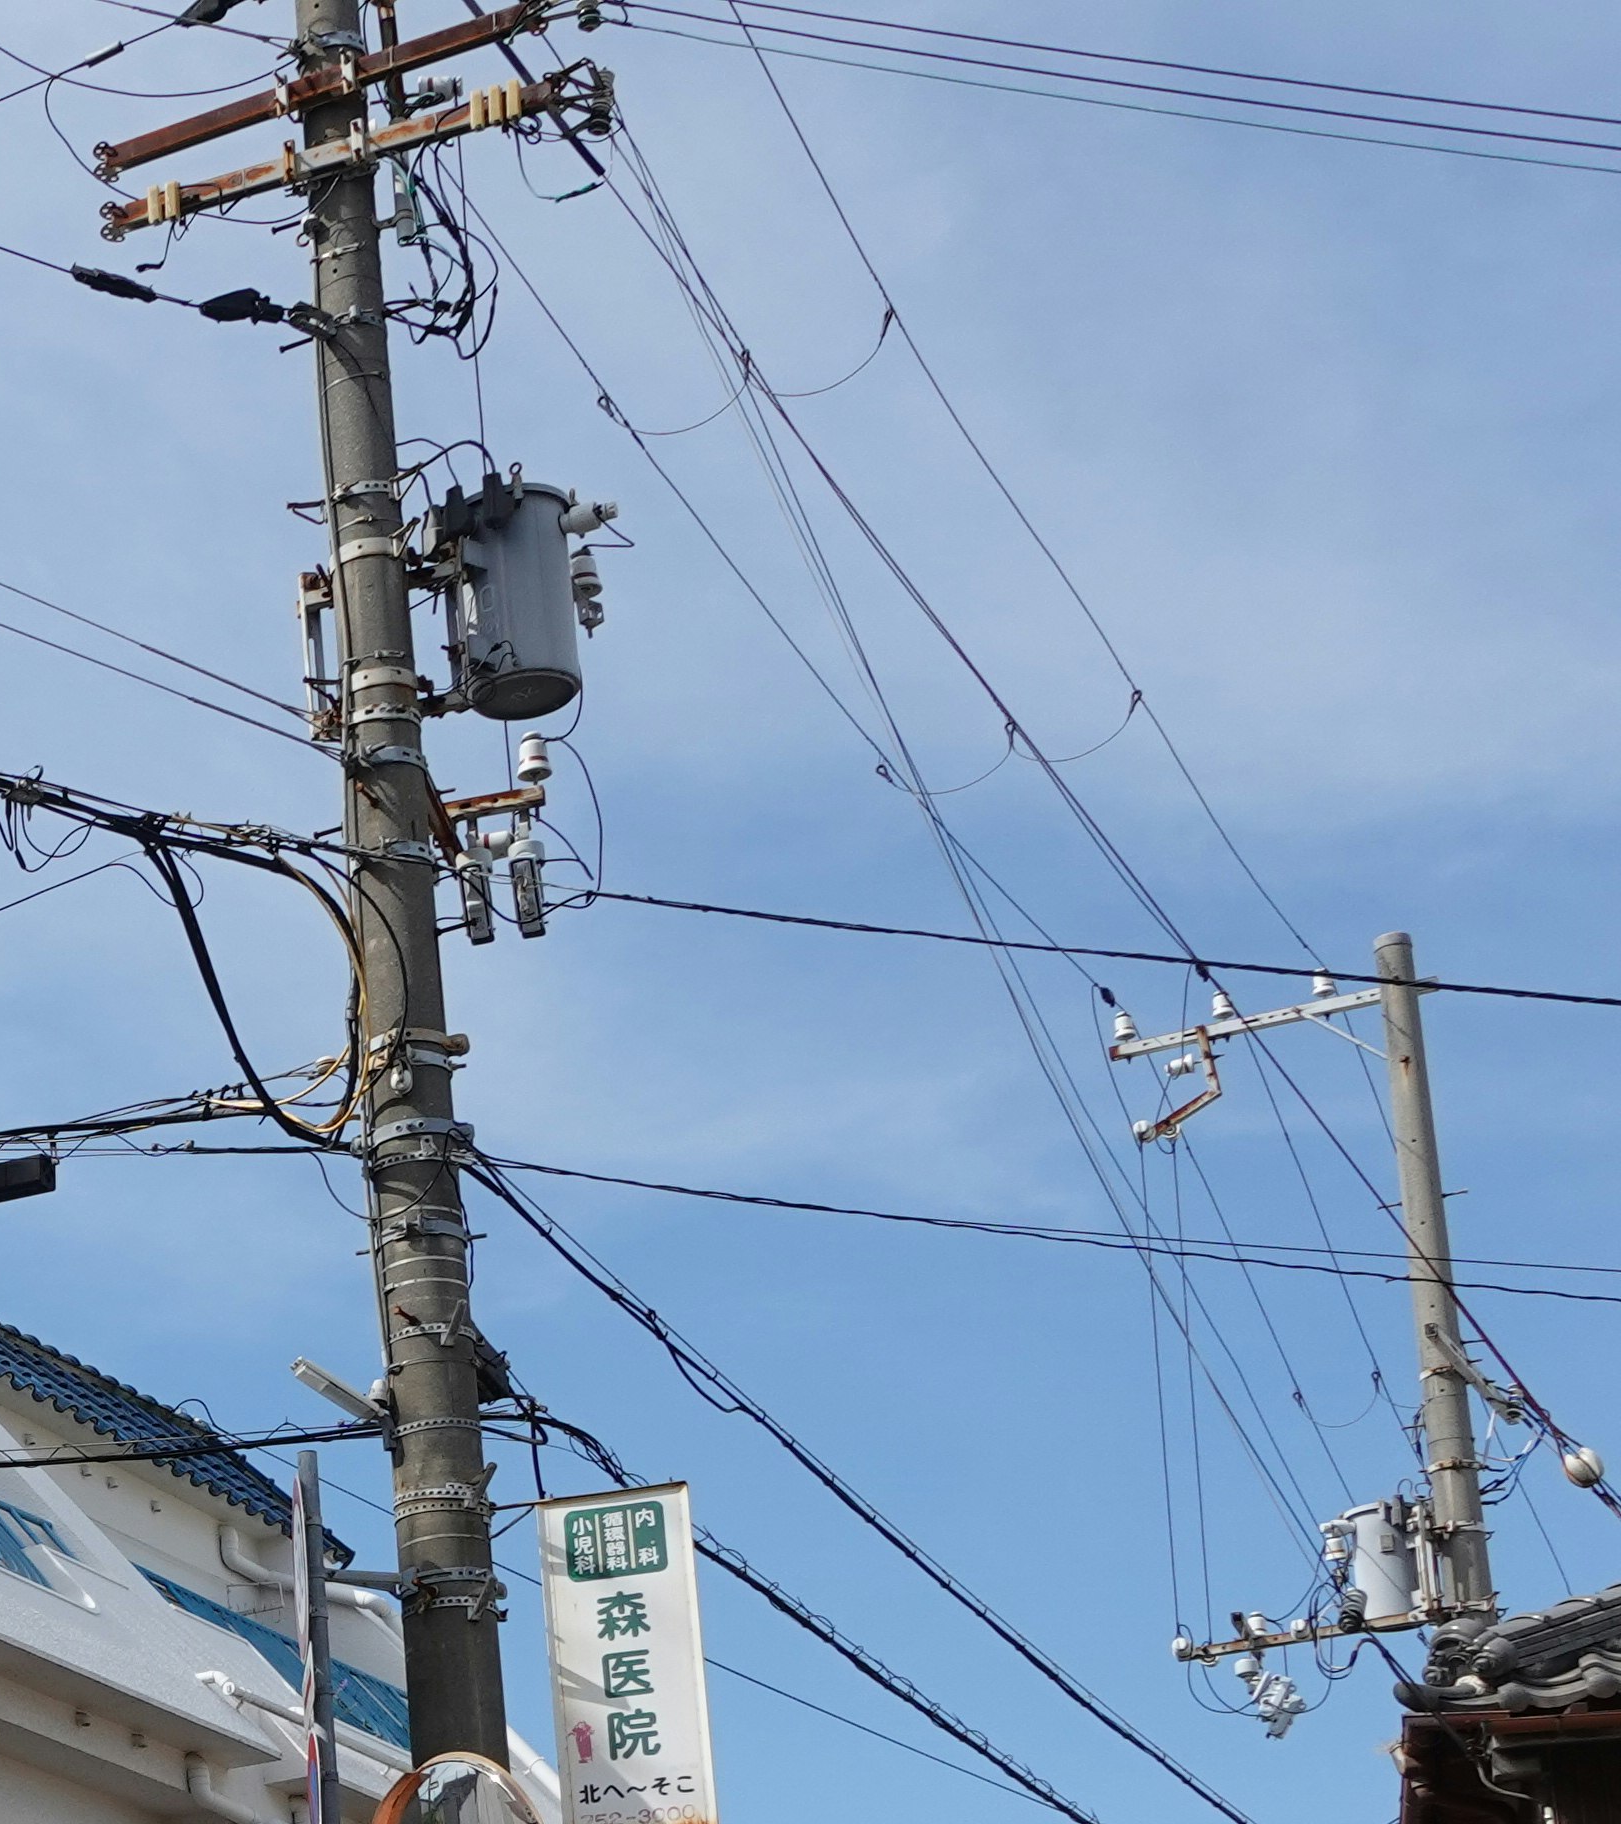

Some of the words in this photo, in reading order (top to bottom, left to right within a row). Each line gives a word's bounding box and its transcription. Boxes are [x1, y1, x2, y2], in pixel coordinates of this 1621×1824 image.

[571, 1517, 596, 1575] 小児科
[602, 1511, 628, 1572] 循環器科
[596, 1590, 661, 1761] 森医院
